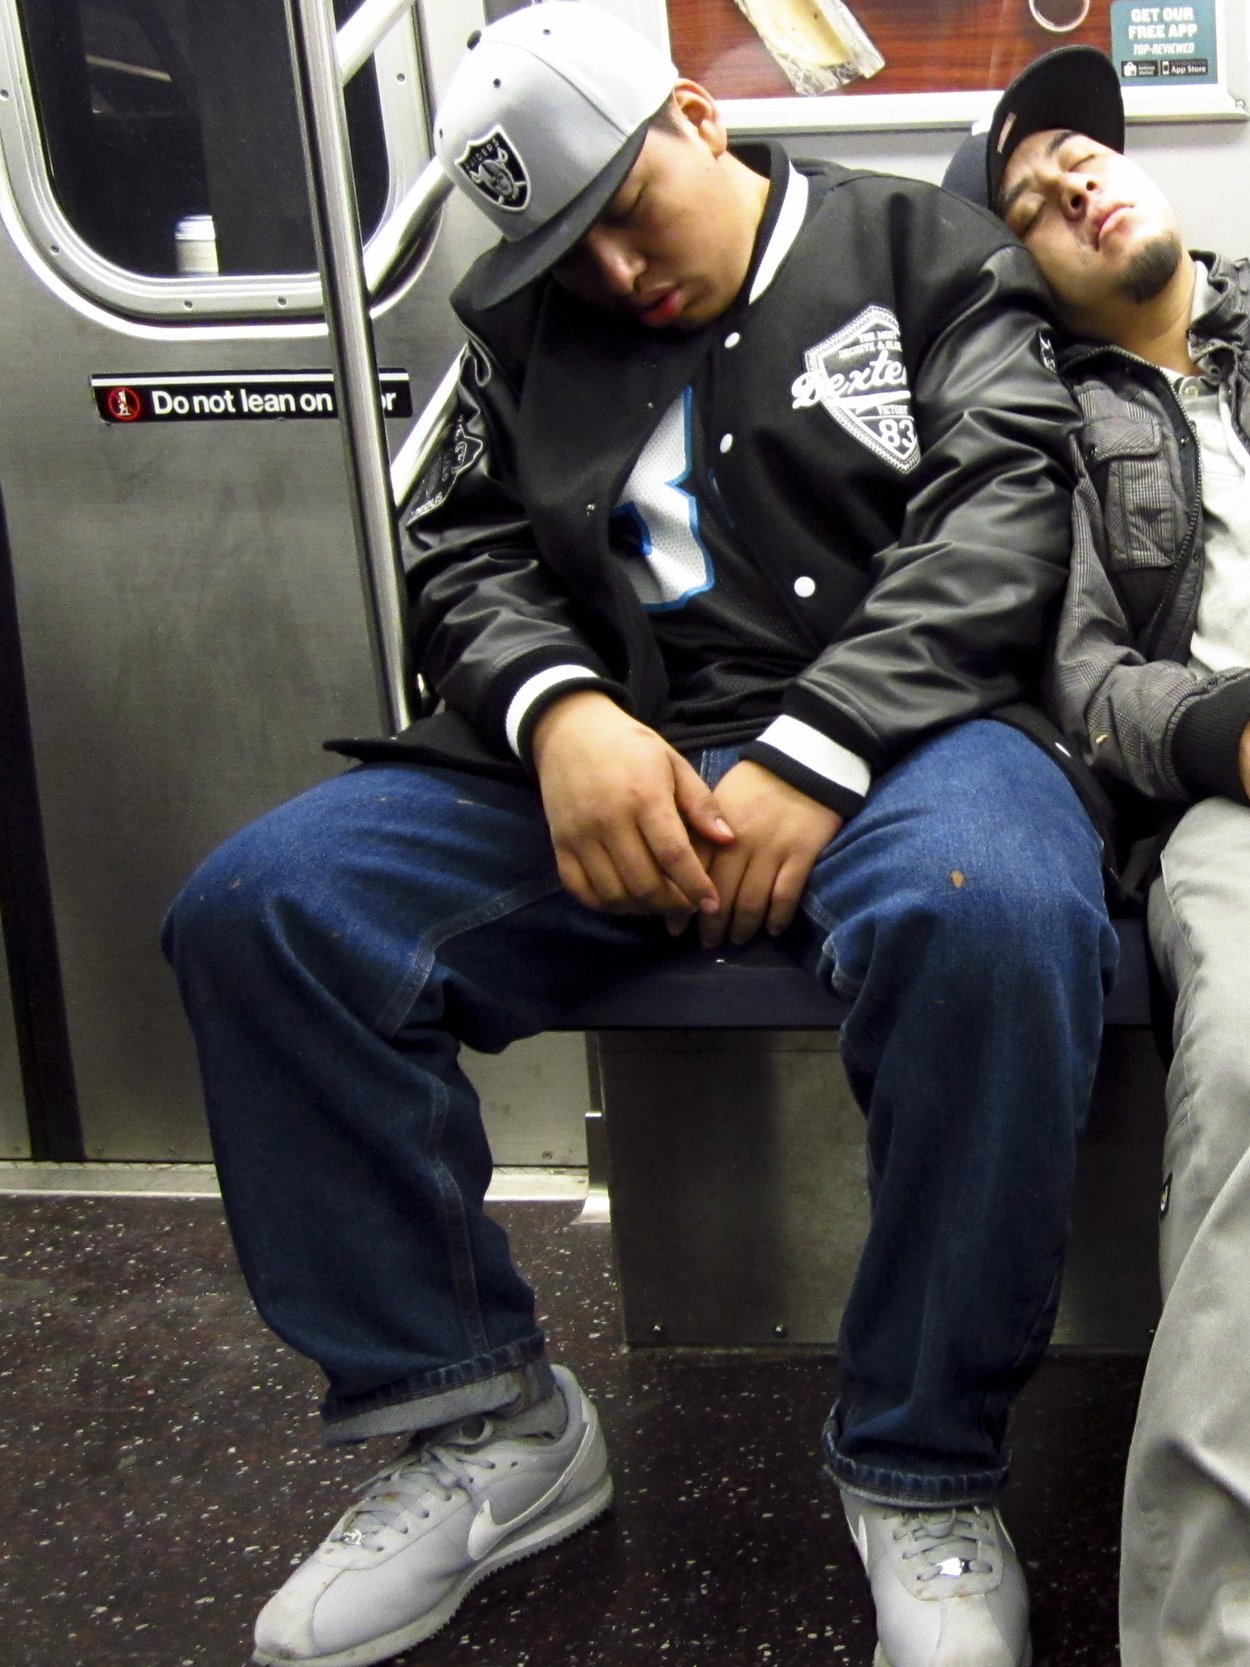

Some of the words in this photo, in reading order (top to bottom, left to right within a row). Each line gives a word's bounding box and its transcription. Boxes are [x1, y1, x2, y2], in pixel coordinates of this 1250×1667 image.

[1131, 8, 1159, 22] GET
[1162, 7, 1194, 21] OUR
[1128, 24, 1165, 39] FREE
[1168, 23, 1198, 38] APP
[1133, 42, 1195, 55] TOP-REVIEWED
[1171, 66, 1186, 74] App
[1187, 65, 1206, 73] Store
[151, 390, 189, 414] Do
[193, 390, 236, 414] not
[240, 388, 296, 412] lean
[299, 392, 333, 412] on
[878, 418, 915, 449] 83
